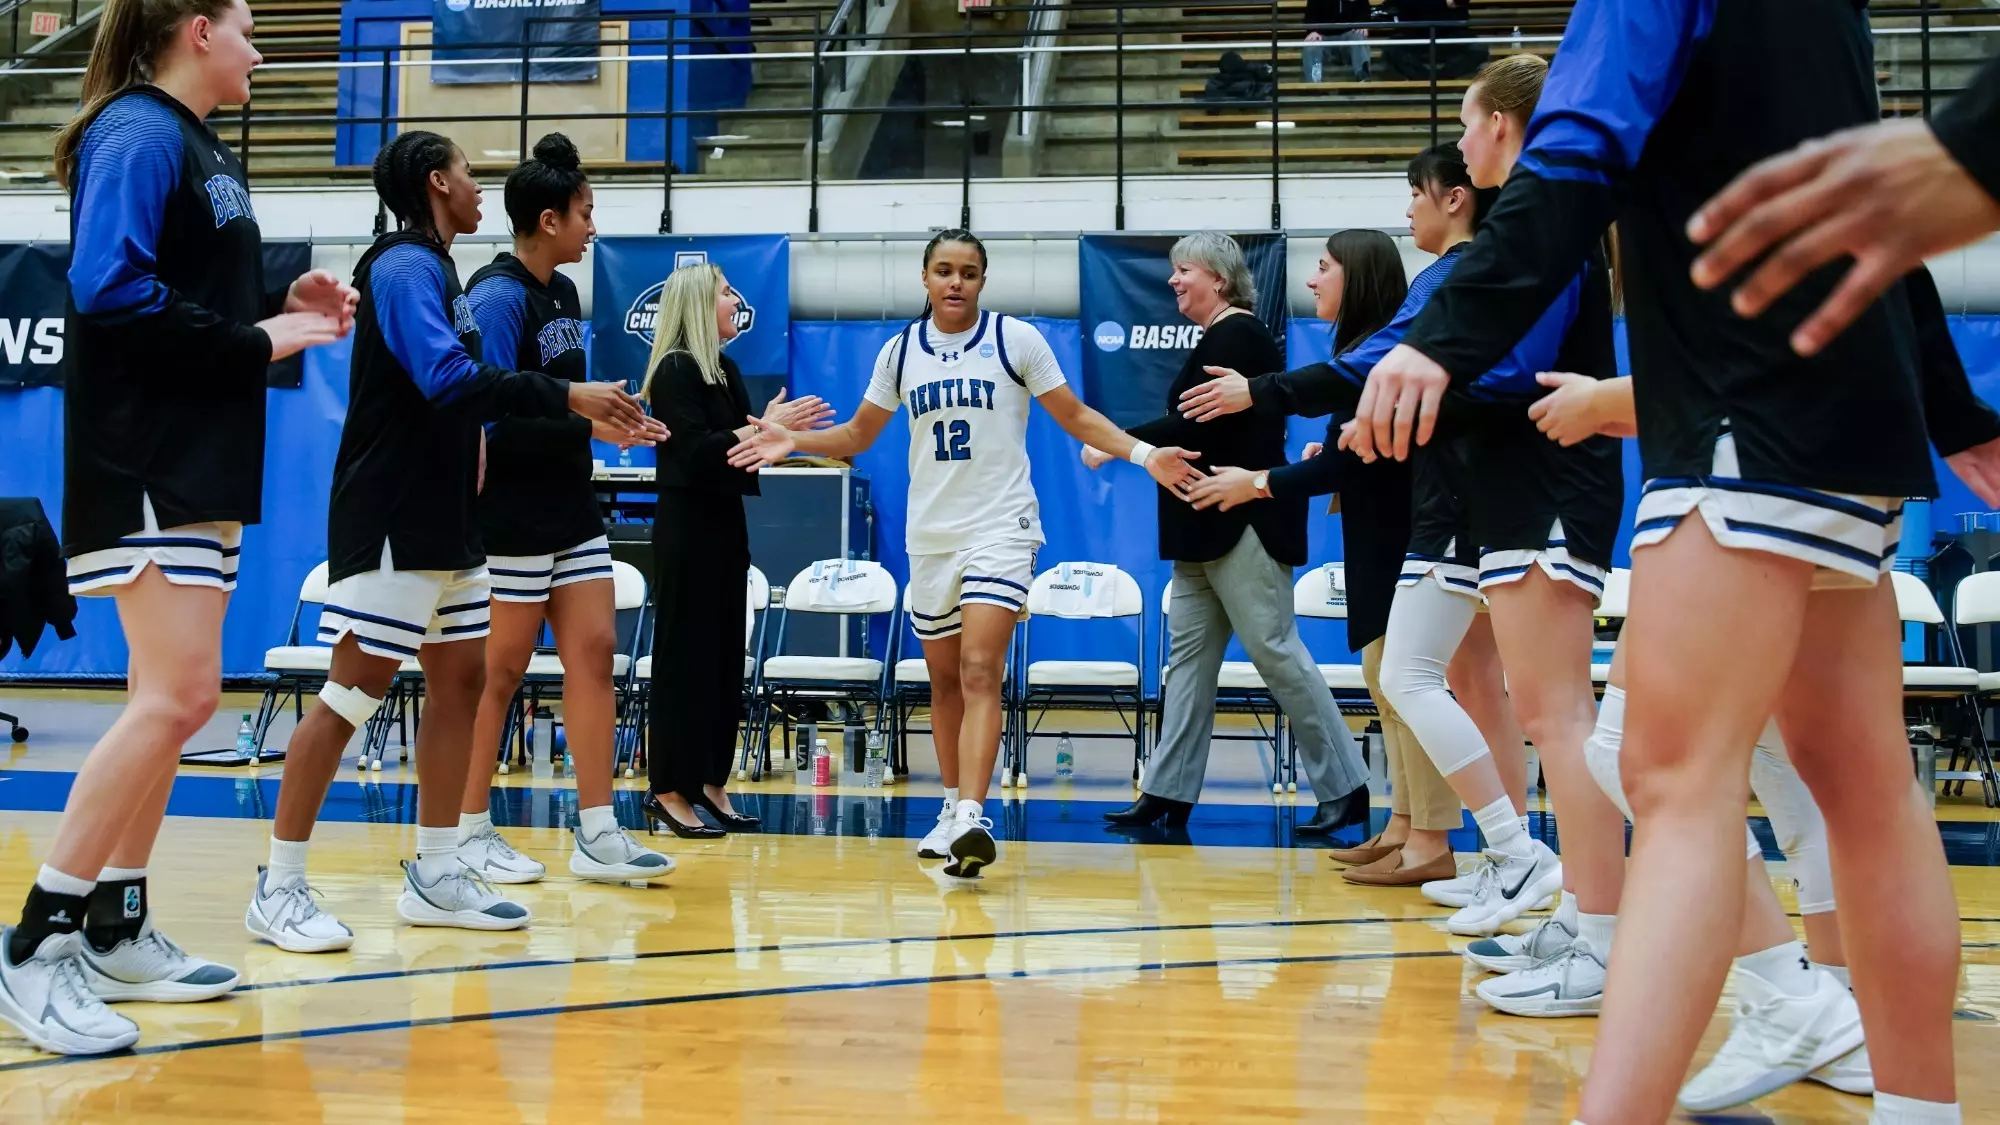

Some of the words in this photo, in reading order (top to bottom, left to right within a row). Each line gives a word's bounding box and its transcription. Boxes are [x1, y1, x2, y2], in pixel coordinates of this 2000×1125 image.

[34, 15, 59, 33] EXIT
[909, 378, 996, 421] BENTLEY
[932, 419, 972, 462] 12
